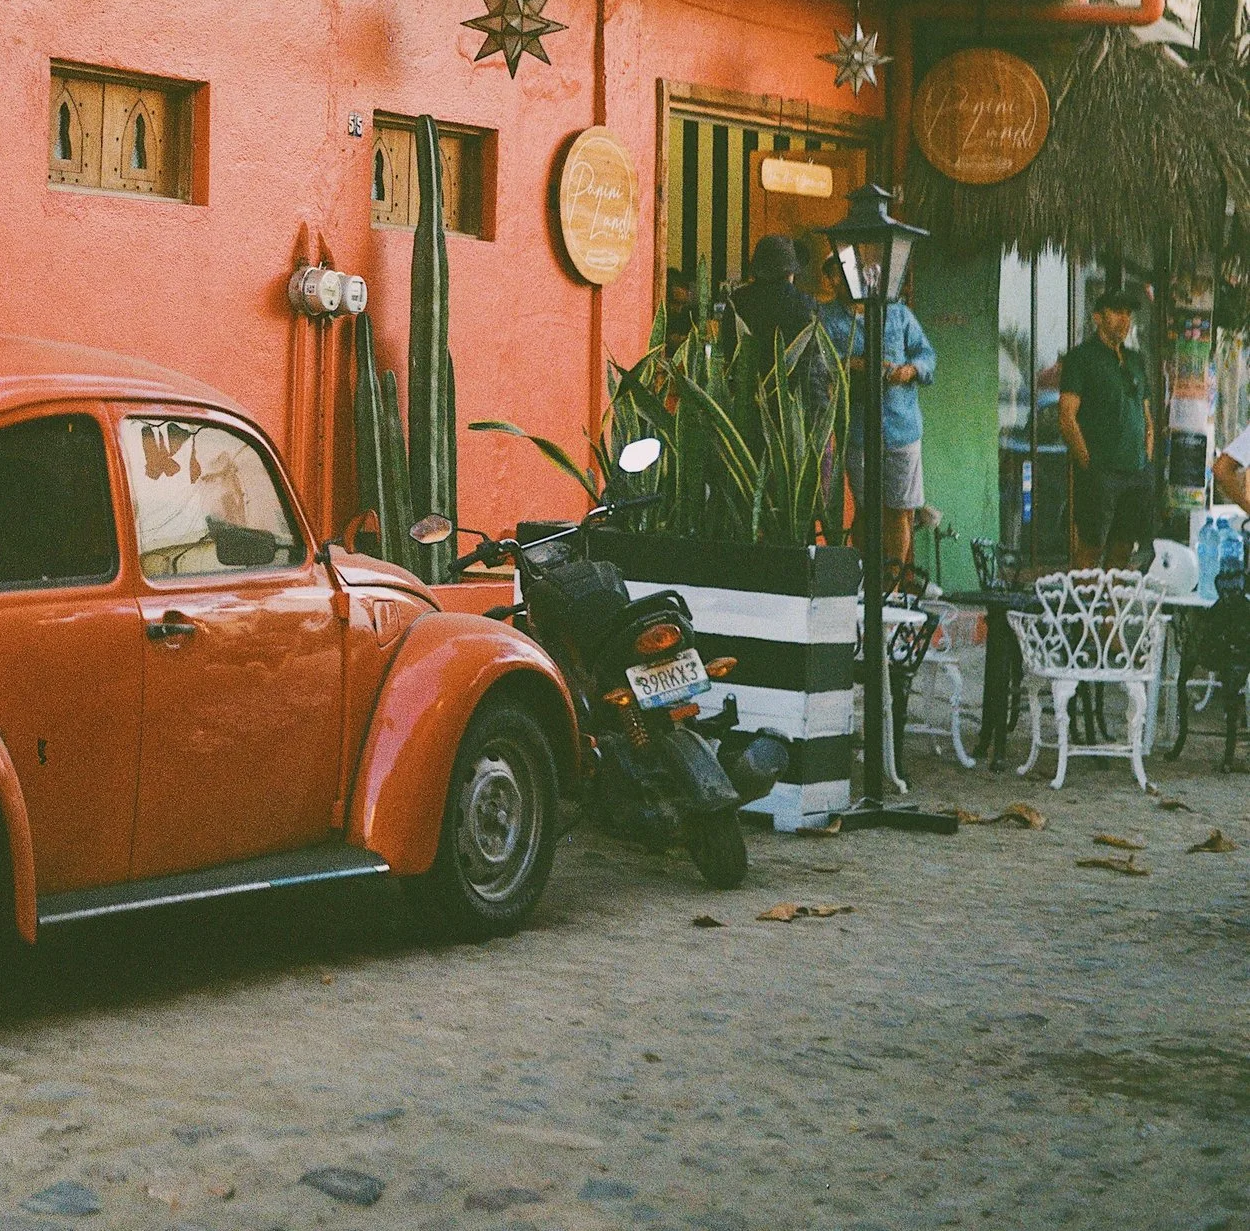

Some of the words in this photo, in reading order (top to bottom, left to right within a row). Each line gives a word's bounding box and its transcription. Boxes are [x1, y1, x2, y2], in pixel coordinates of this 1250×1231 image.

[349, 114, 362, 135] 55
[569, 161, 623, 224] Panini
[590, 196, 631, 240] Land
[641, 661, 698, 695] 89RKX3
